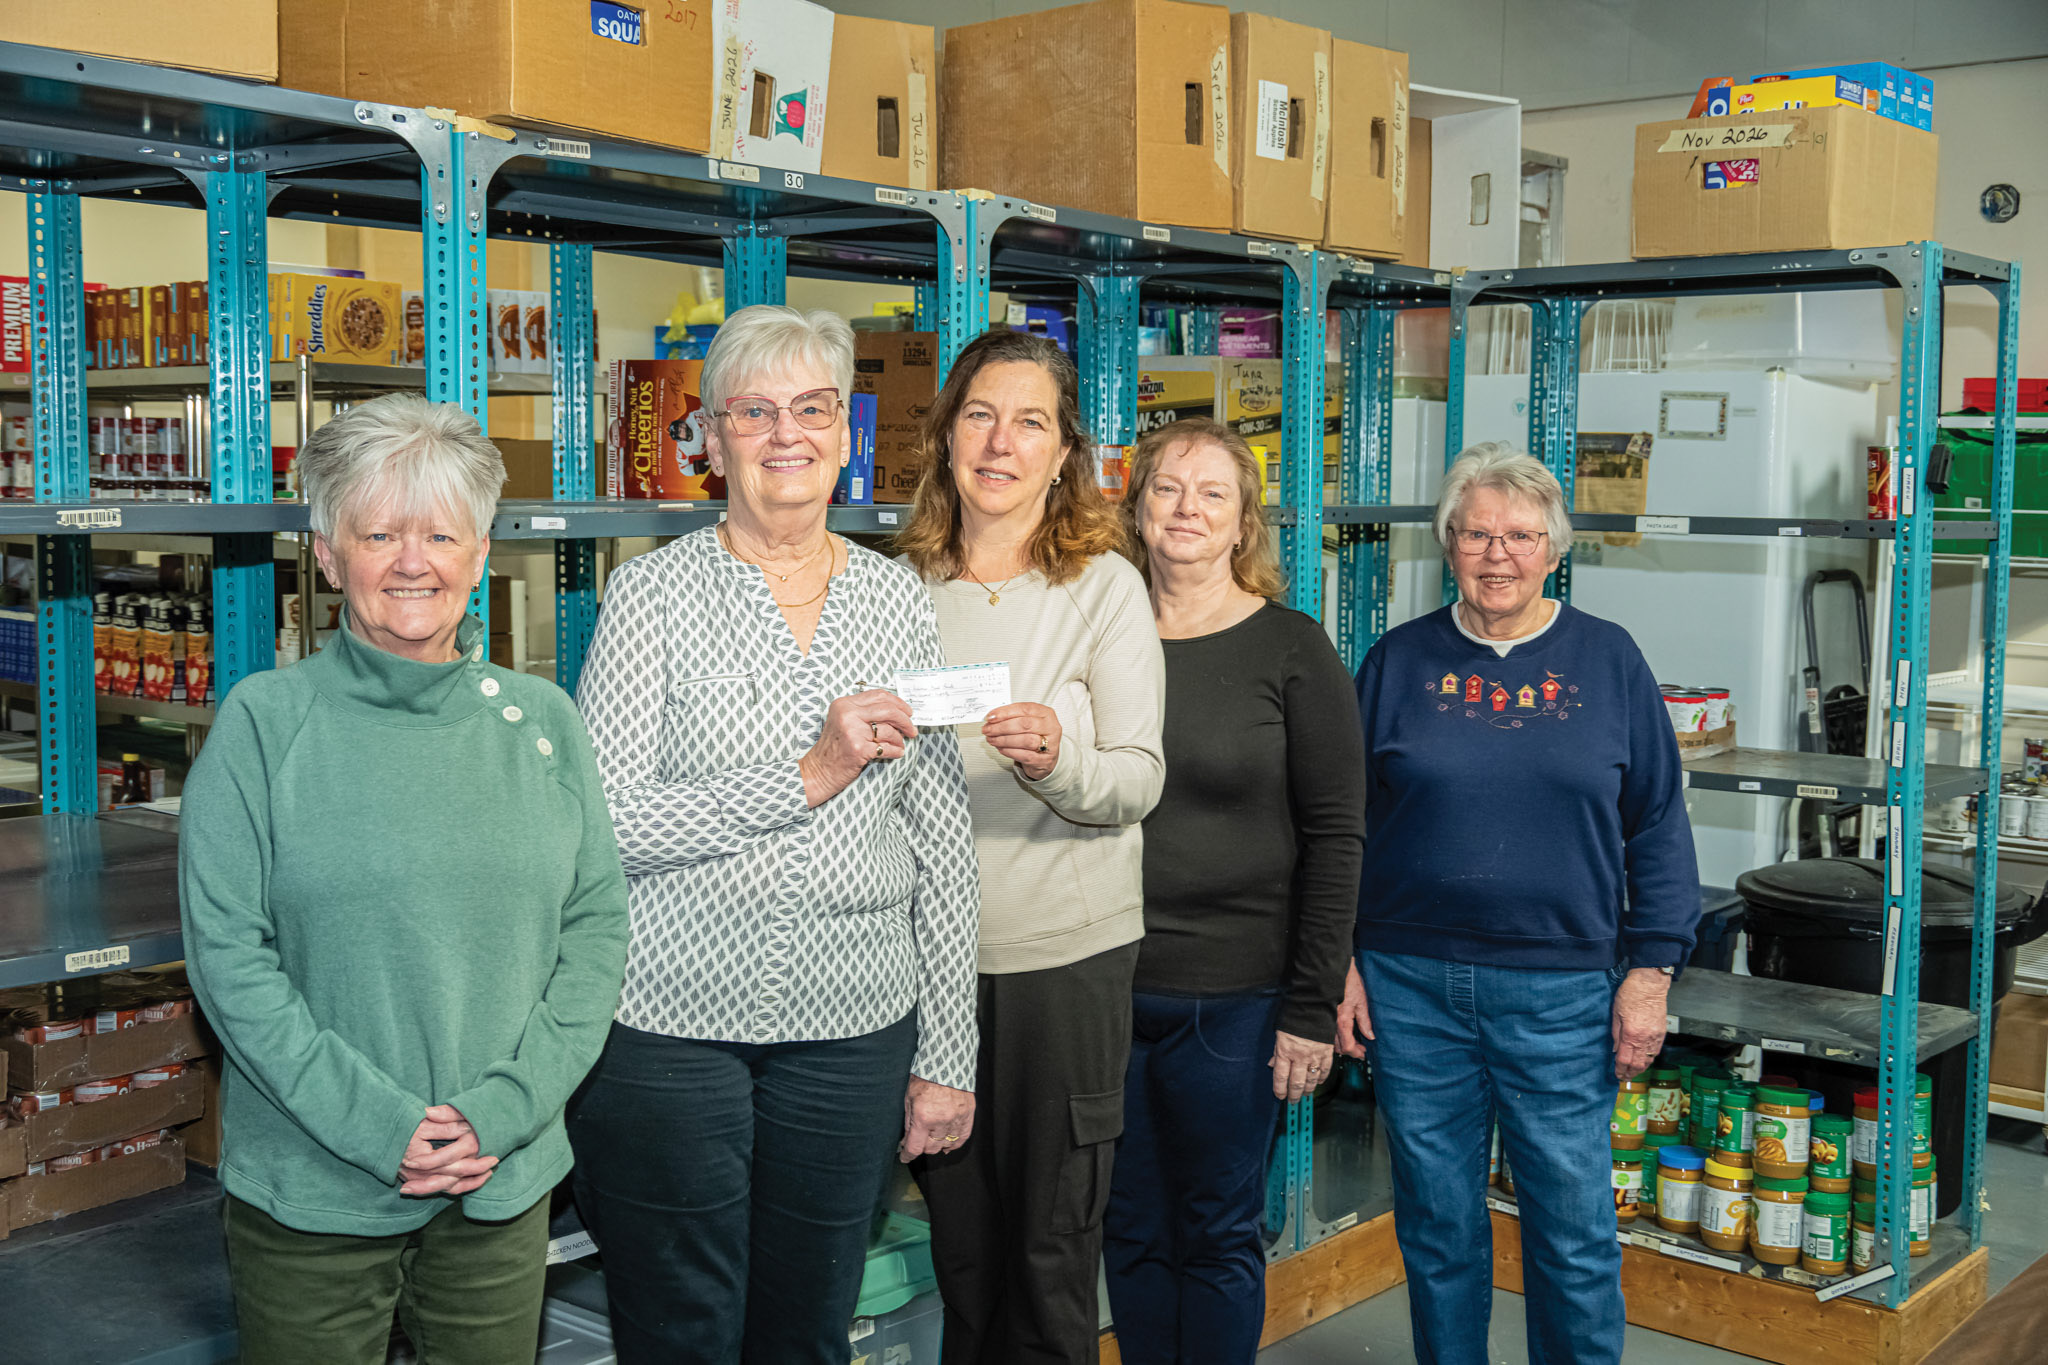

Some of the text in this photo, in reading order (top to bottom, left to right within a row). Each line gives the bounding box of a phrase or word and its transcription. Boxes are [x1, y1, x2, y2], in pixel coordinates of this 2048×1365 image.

[617, 10, 640, 23] OATM
[665, 0, 697, 30] 2017
[598, 17, 640, 44] SQUA
[722, 47, 738, 129] JUNE 2026
[912, 113, 923, 138] JUL
[1277, 100, 1287, 149] McIntosh
[1682, 127, 1768, 149] Nov 2026
[786, 174, 803, 188] 30
[3, 282, 23, 362] PREMIUM
[307, 284, 328, 353] Shreddies
[629, 387, 638, 440] Honey Nut
[634, 380, 654, 473] Cheerios
[1768, 1041, 1790, 1049] JUNE
